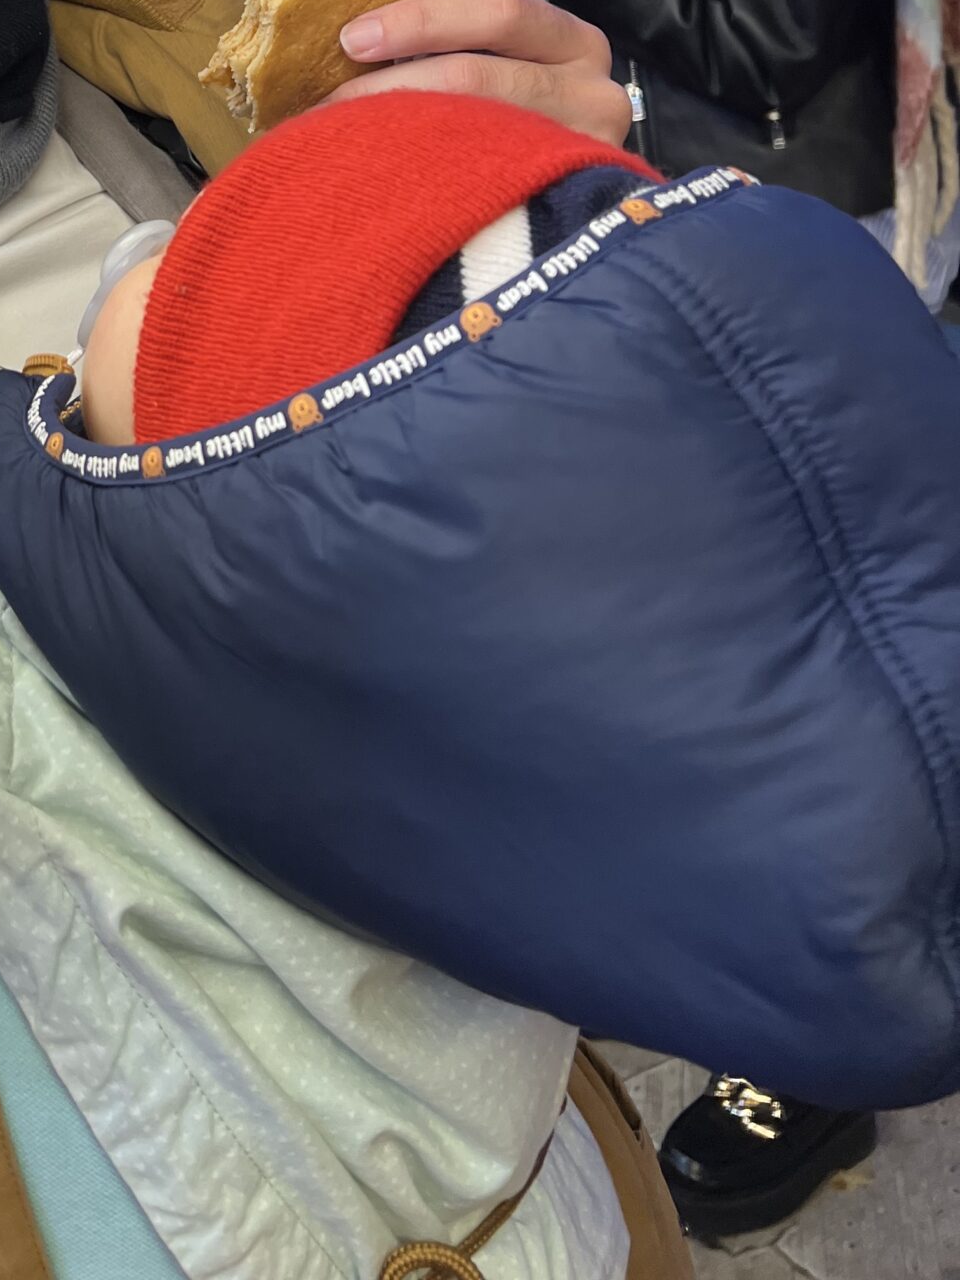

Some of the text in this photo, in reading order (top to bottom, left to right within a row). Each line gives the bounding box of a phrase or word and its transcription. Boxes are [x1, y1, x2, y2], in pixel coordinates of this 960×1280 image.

[496, 209, 628, 312] my little bear
[321, 323, 462, 410] my little bear
[61, 448, 140, 479] my little bear
[165, 411, 287, 468] my little bear
